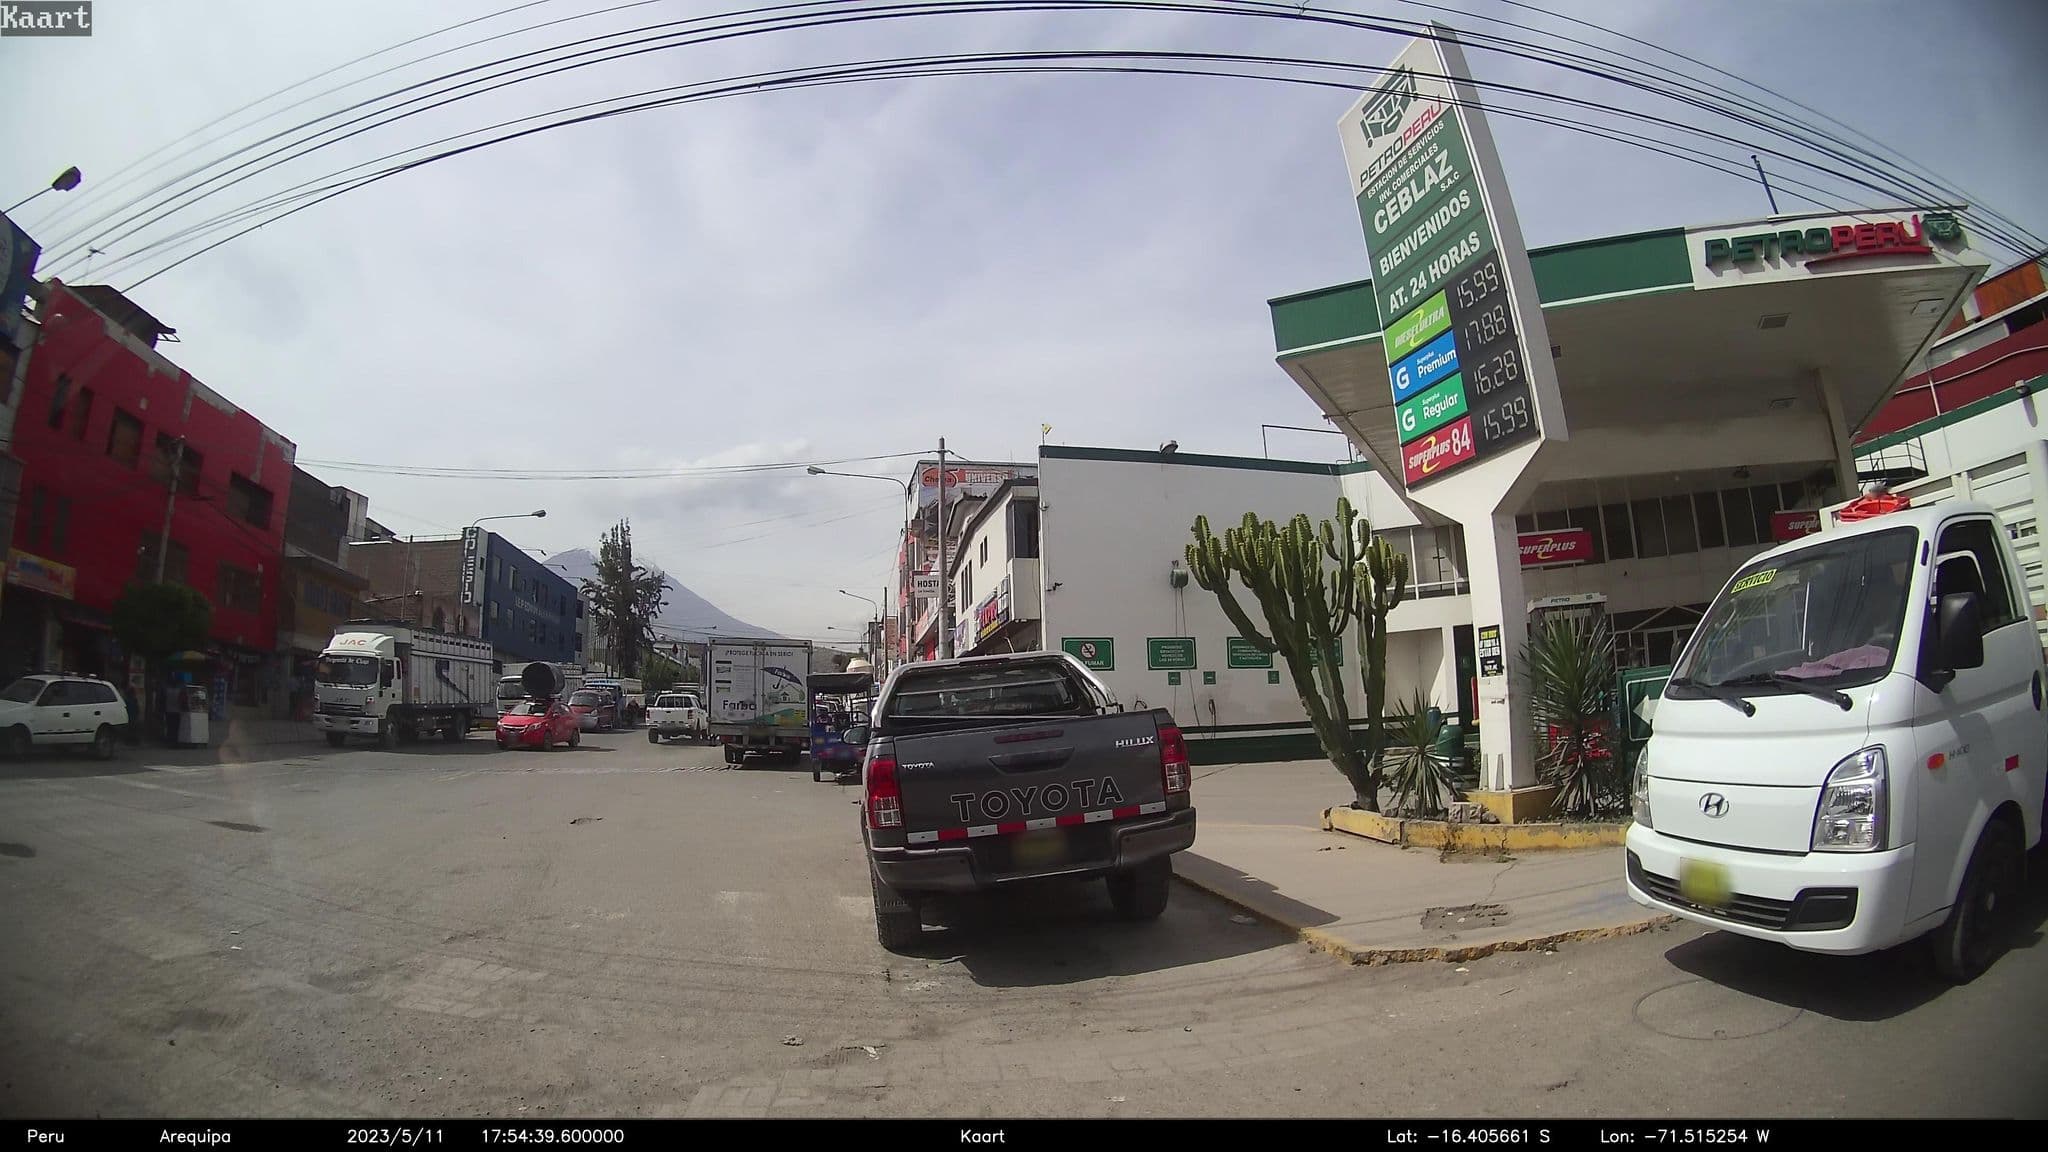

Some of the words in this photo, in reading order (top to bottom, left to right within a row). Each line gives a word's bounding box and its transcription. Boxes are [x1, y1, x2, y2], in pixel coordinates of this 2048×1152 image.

[1367, 166, 1398, 199] ESTACION
[1398, 156, 1408, 169] DE
[1408, 120, 1444, 159] SERVICIOS
[1392, 143, 1439, 191] COMERCIALES
[1374, 149, 1454, 235] CEBLAZ
[1380, 189, 1471, 277] BIENVENIDOS
[1704, 214, 1922, 267] PETROPERU
[1390, 287, 1409, 314] AT.
[1410, 274, 1428, 299] 24
[1430, 231, 1481, 283] HORAS
[1456, 262, 1499, 310] 15.99
[1396, 366, 1410, 390] G
[1417, 349, 1457, 379] Premium
[1464, 304, 1507, 351] 17.88
[1402, 408, 1416, 432] G
[1423, 393, 1459, 420] Regular
[1473, 349, 1518, 395] 16.28
[1451, 423, 1471, 456] 84
[1482, 396, 1529, 441] 15.99
[1519, 541, 1577, 555] SUPERPLUS
[917, 580, 939, 588] HOST
[339, 638, 367, 646] JAC
[902, 761, 935, 770] TOYOTA
[1115, 735, 1155, 749] HILUX
[950, 776, 1124, 823] TOYOTA
